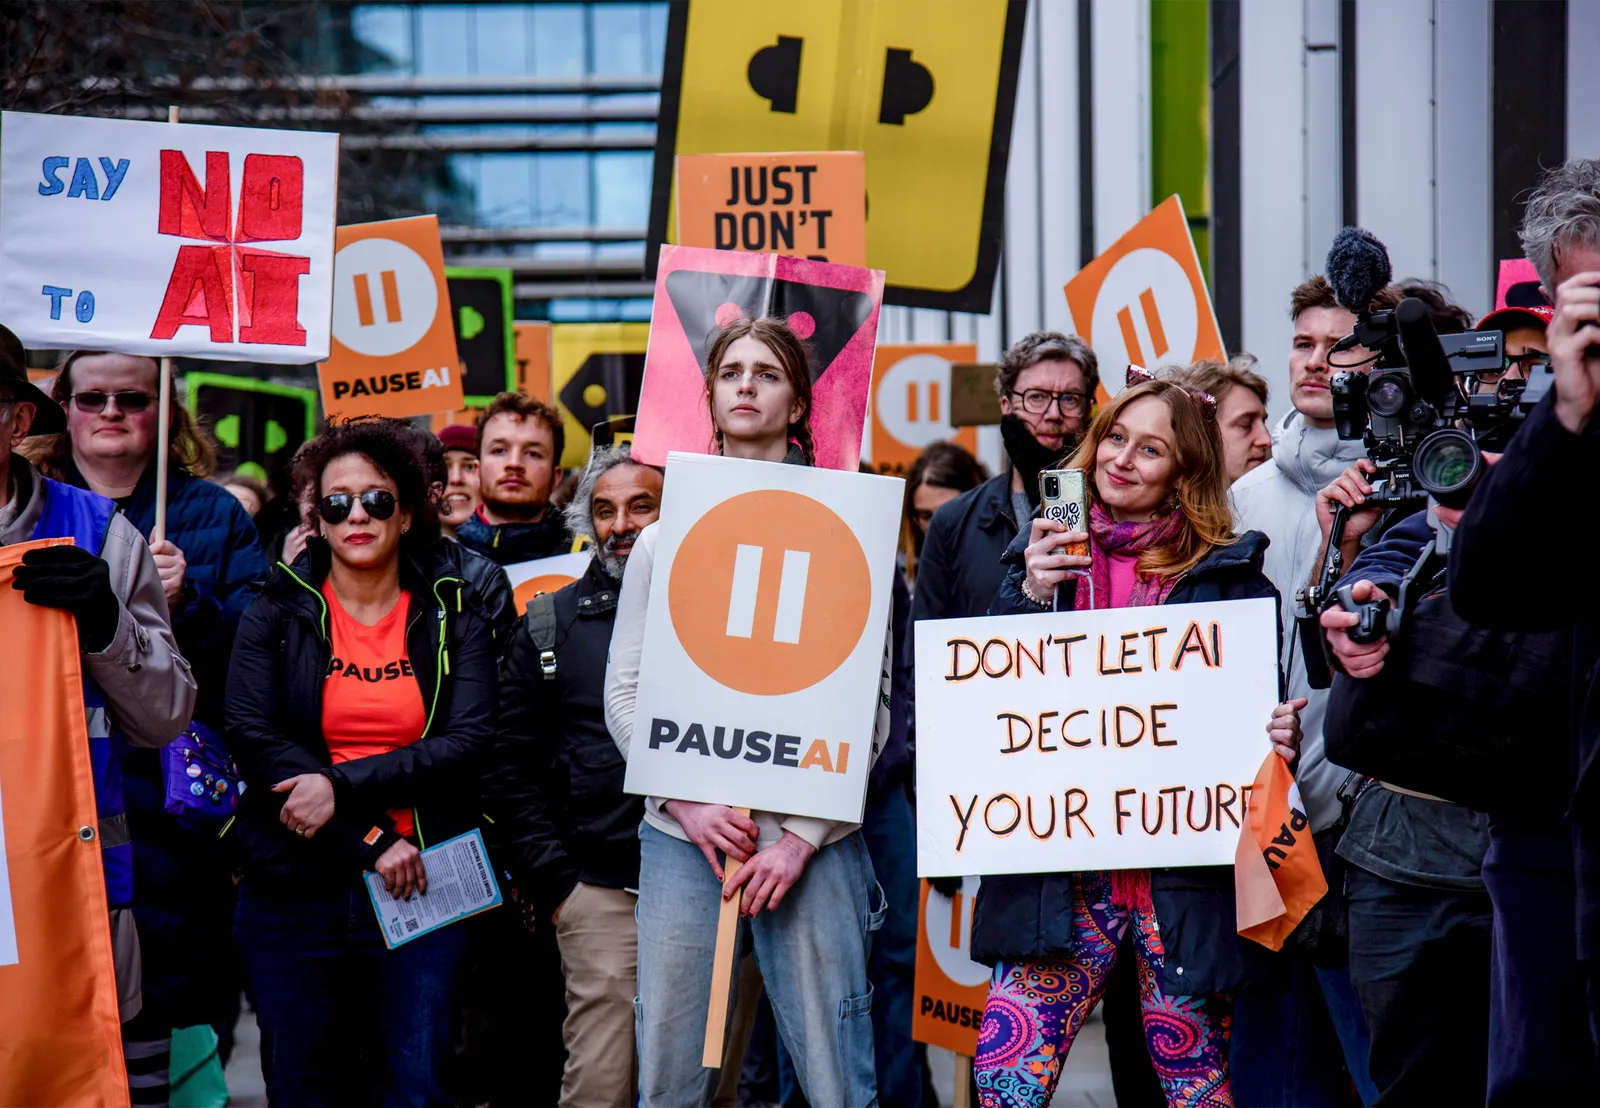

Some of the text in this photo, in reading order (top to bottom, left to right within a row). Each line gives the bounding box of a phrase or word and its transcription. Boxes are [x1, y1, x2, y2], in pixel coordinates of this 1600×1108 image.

[38, 149, 304, 243] SAY NO
[726, 165, 818, 206] JUST
[714, 210, 832, 251] DON'T
[42, 244, 310, 346] TO AI
[332, 367, 451, 400] PAUSEAI
[327, 657, 415, 683] PAUSE
[944, 620, 1222, 683] DON'T LET AI
[648, 717, 850, 774] PAUSEAI
[997, 703, 1178, 754] DECIDE
[949, 786, 1095, 853] YOUR
[1263, 807, 1308, 870] PAU
